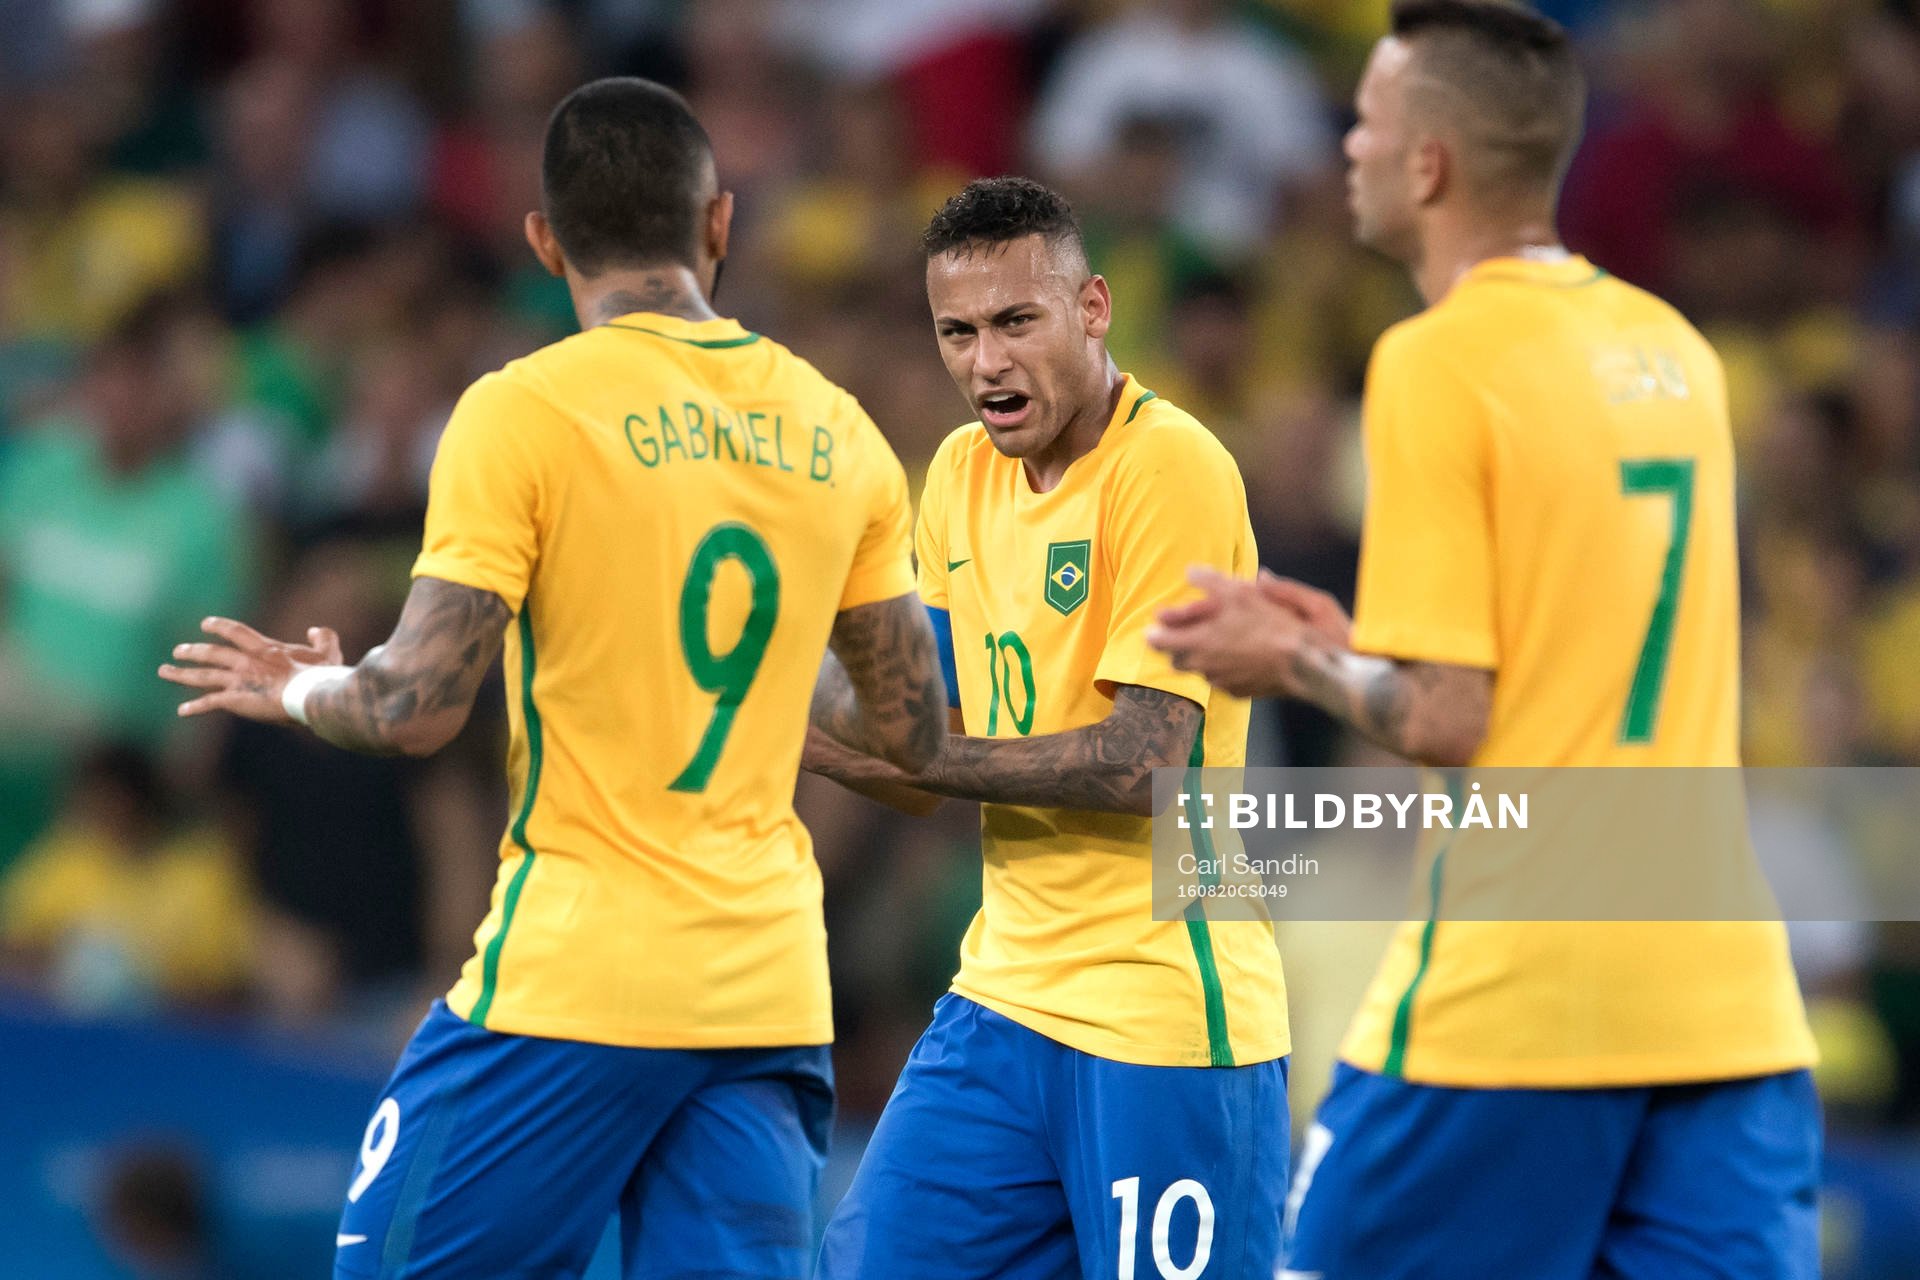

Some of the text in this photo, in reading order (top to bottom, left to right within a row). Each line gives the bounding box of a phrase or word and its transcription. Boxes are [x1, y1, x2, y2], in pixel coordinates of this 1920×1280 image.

[624, 402, 836, 488] GABRIEL B.
[1617, 459, 1695, 746] 7
[666, 521, 780, 793] 9
[985, 630, 1036, 737] 10
[348, 1096, 400, 1204] 9
[1112, 1176, 1215, 1280] 10
